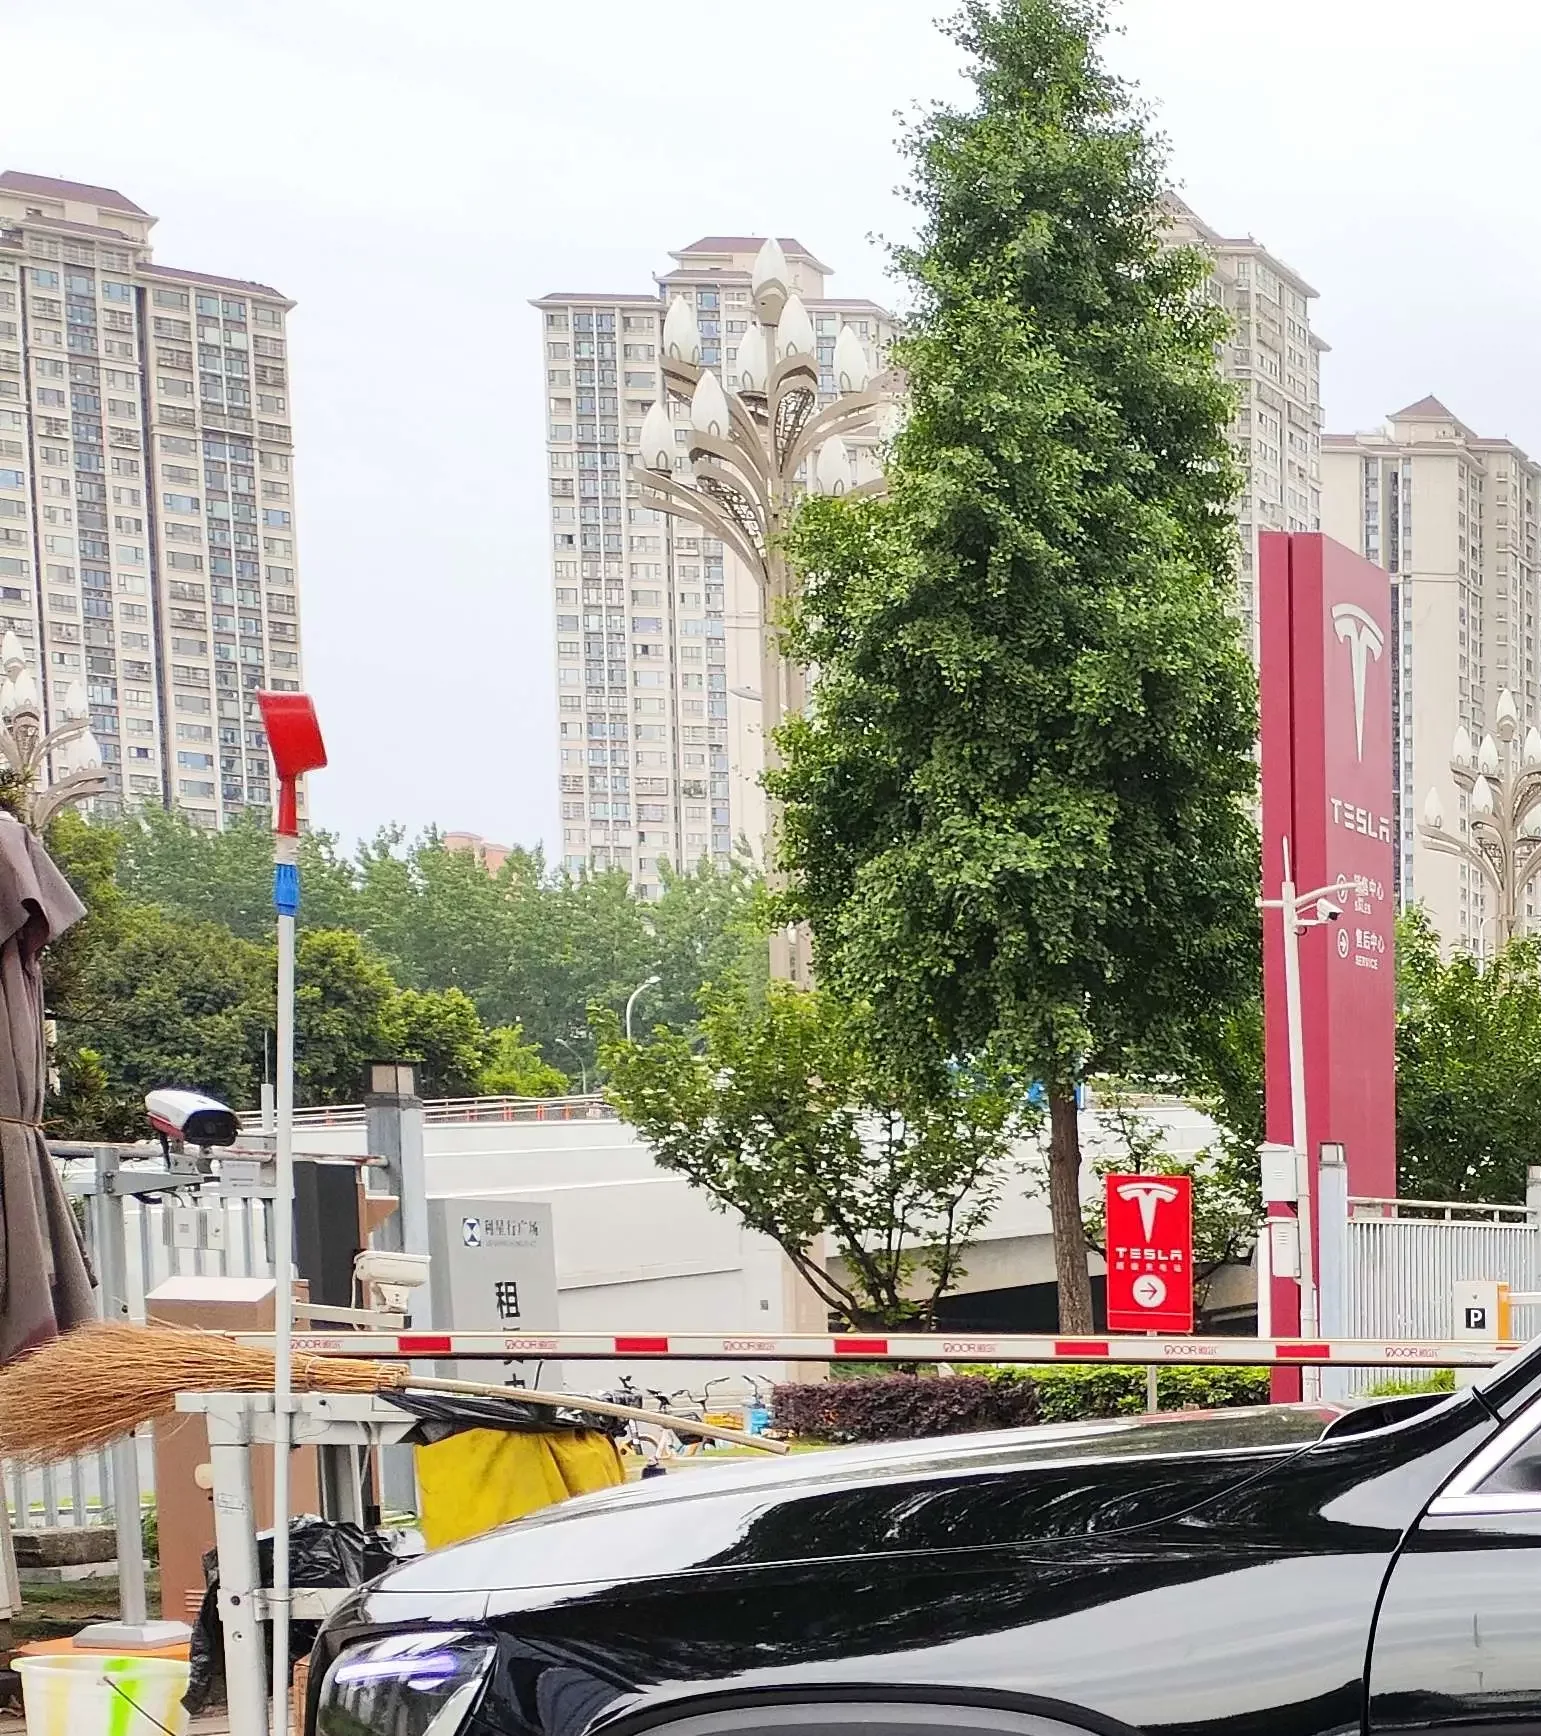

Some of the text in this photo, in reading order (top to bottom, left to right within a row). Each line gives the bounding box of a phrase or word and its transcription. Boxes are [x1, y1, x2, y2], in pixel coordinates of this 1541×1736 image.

[1330, 797, 1391, 843] TESLA
[1355, 928, 1385, 954] 售后中心
[1115, 1247, 1183, 1261] TESLA
[1470, 1309, 1483, 1328] P
